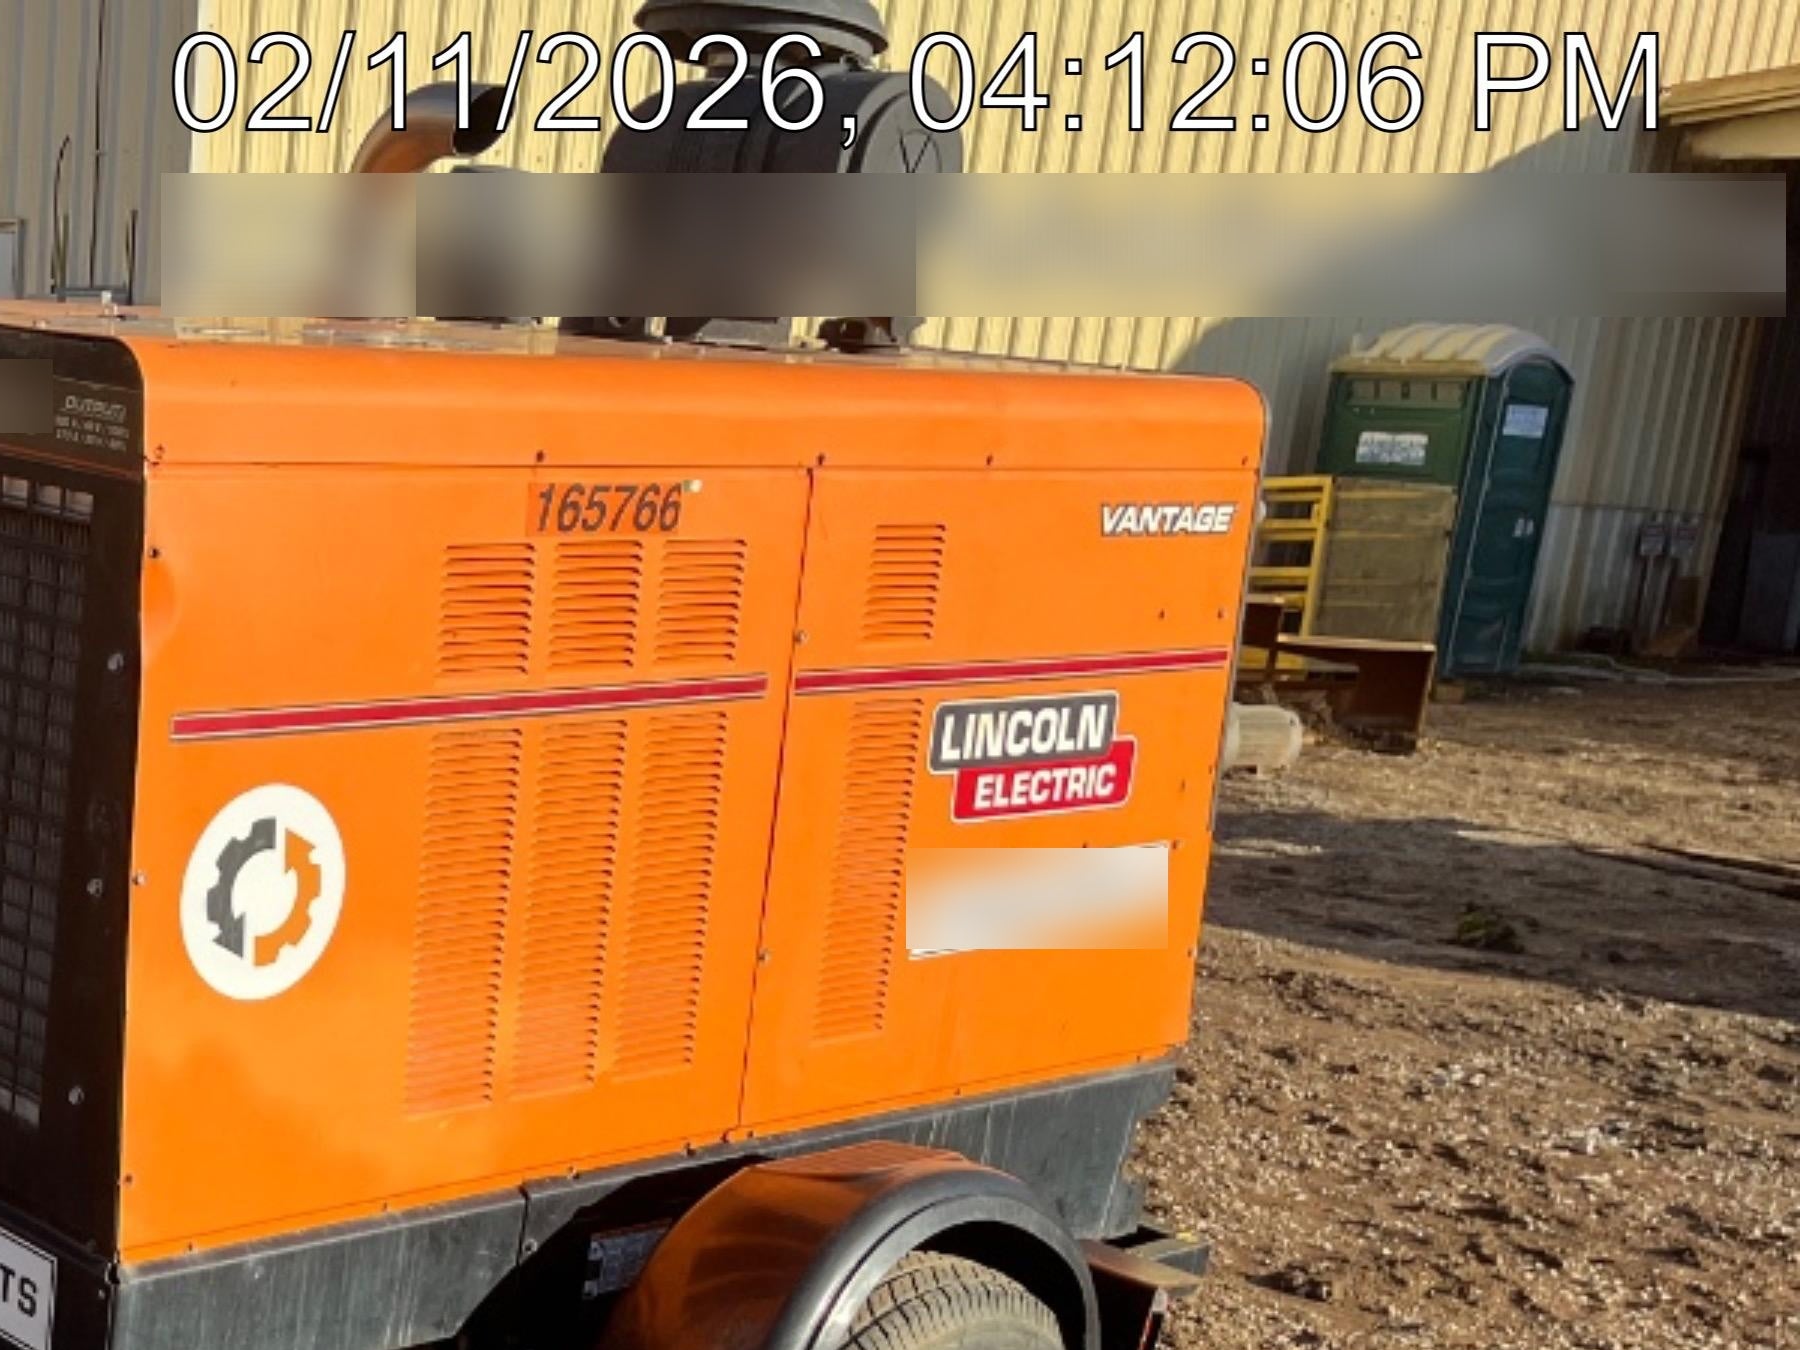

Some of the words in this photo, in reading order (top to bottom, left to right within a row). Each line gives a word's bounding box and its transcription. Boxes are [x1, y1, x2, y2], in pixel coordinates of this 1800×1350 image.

[538, 483, 682, 532] 165766
[1101, 504, 1235, 536] VANTAGE
[940, 704, 1108, 762] LINCOLN
[973, 763, 1117, 811] ELECTRIC
